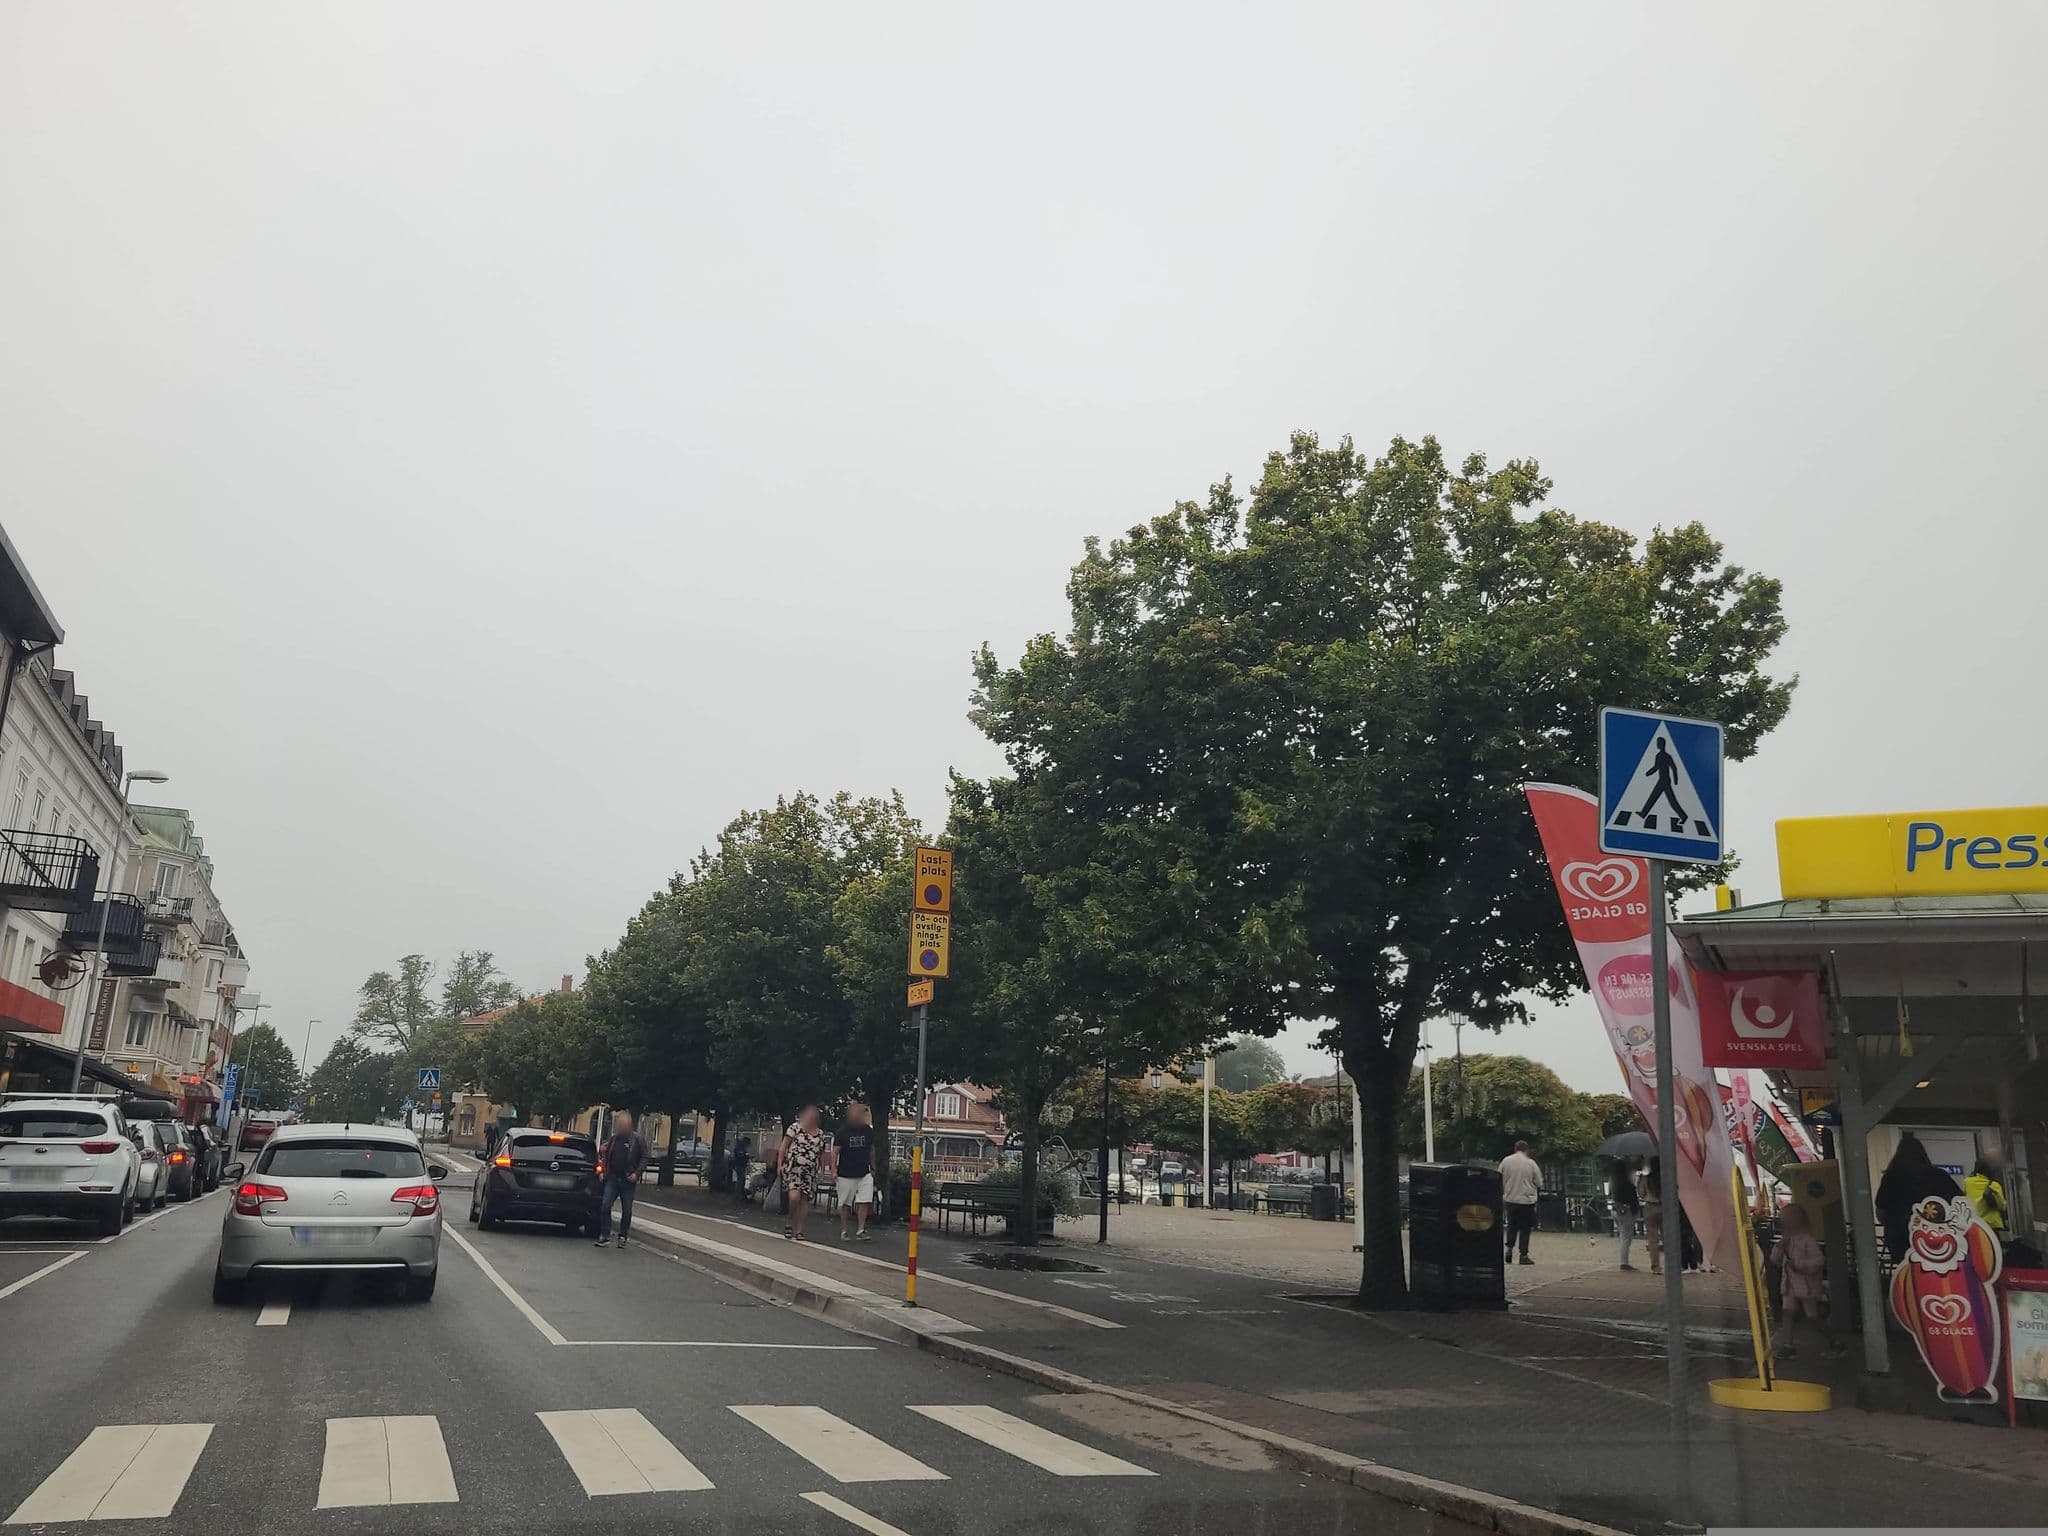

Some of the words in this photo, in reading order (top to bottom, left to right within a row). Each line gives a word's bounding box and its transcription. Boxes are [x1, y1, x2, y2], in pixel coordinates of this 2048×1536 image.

[1907, 822, 2048, 872] Pres
[921, 854, 948, 864] Last-
[921, 866, 947, 876] plats
[933, 916, 948, 924] och
[915, 923, 946, 933] avstig-
[917, 931, 944, 940] nings-
[920, 939, 941, 948] plats
[95, 981, 111, 1037] RESTAURANG
[1727, 1042, 1775, 1052] SVENSKA
[1779, 1043, 1804, 1052] SPEL
[1942, 1327, 1976, 1336] GLACE
